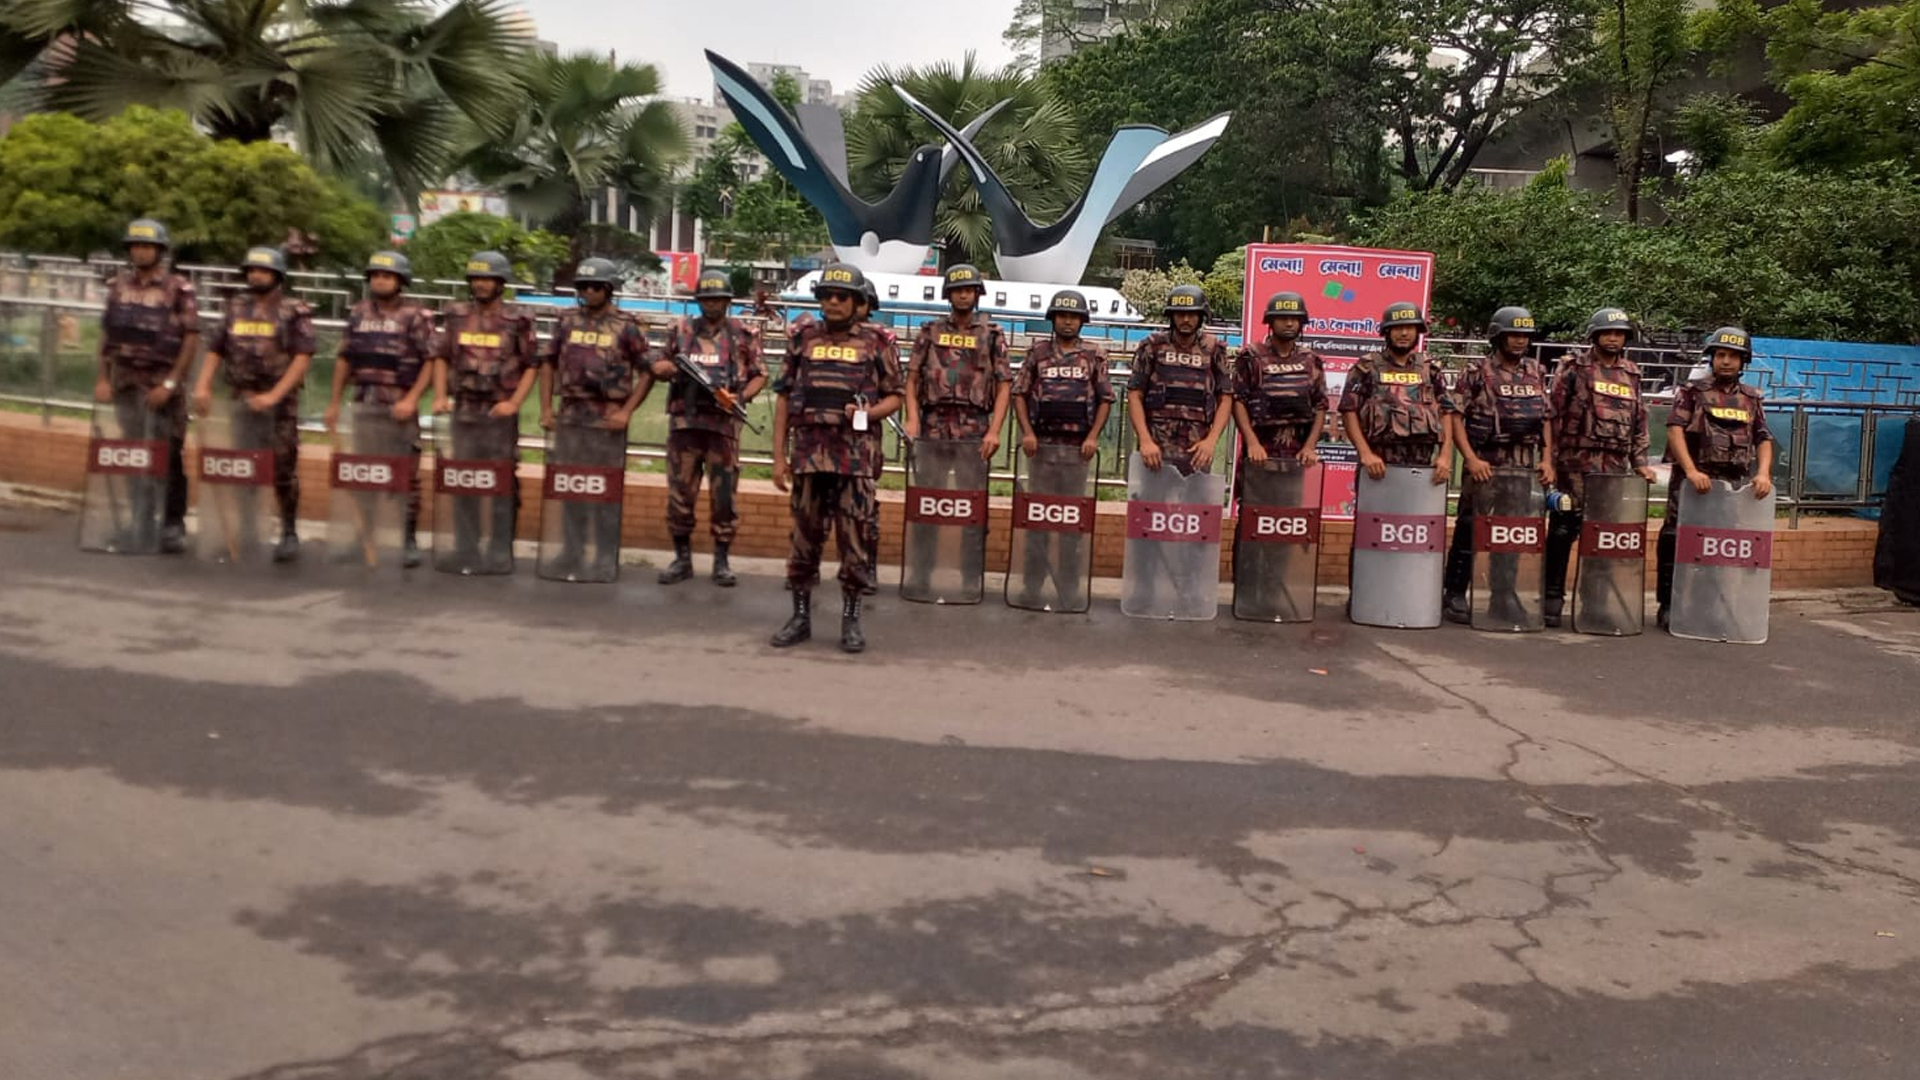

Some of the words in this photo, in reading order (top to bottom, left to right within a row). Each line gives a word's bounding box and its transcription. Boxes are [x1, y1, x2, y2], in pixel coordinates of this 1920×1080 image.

[825, 270, 852, 282] BGB
[950, 270, 973, 281] BGB
[1260, 258, 1304, 274] মেলা!
[1319, 260, 1362, 276] মেলা!
[1378, 264, 1422, 281] মেলা!
[1055, 297, 1078, 308] BGB
[1171, 296, 1194, 306] BGB
[1275, 300, 1298, 310] BGB
[1392, 310, 1416, 320] BGB
[1513, 318, 1535, 328] BGB
[570, 330, 613, 347] BGB
[938, 334, 977, 348] BGB
[1720, 334, 1745, 346] BGB
[812, 346, 856, 361] BGB
[1165, 351, 1202, 367] BGB
[1047, 366, 1084, 379] BGB
[1382, 372, 1421, 384] BGB
[1500, 385, 1536, 396] BGB
[1594, 382, 1632, 397] BGB
[1713, 408, 1749, 422] BGB
[99, 448, 150, 468] BGB
[203, 457, 252, 477] BGB
[338, 462, 392, 484] BGB
[443, 468, 496, 489] BGB
[553, 473, 606, 494] BGB
[919, 496, 973, 518] BGB
[1027, 502, 1081, 525] BGB
[1150, 512, 1201, 536] BGB
[1257, 516, 1308, 536] BGB
[1380, 523, 1428, 544] BGB
[1491, 525, 1538, 545] BGB
[1598, 531, 1641, 550] BGB
[1702, 537, 1753, 559] BGB
